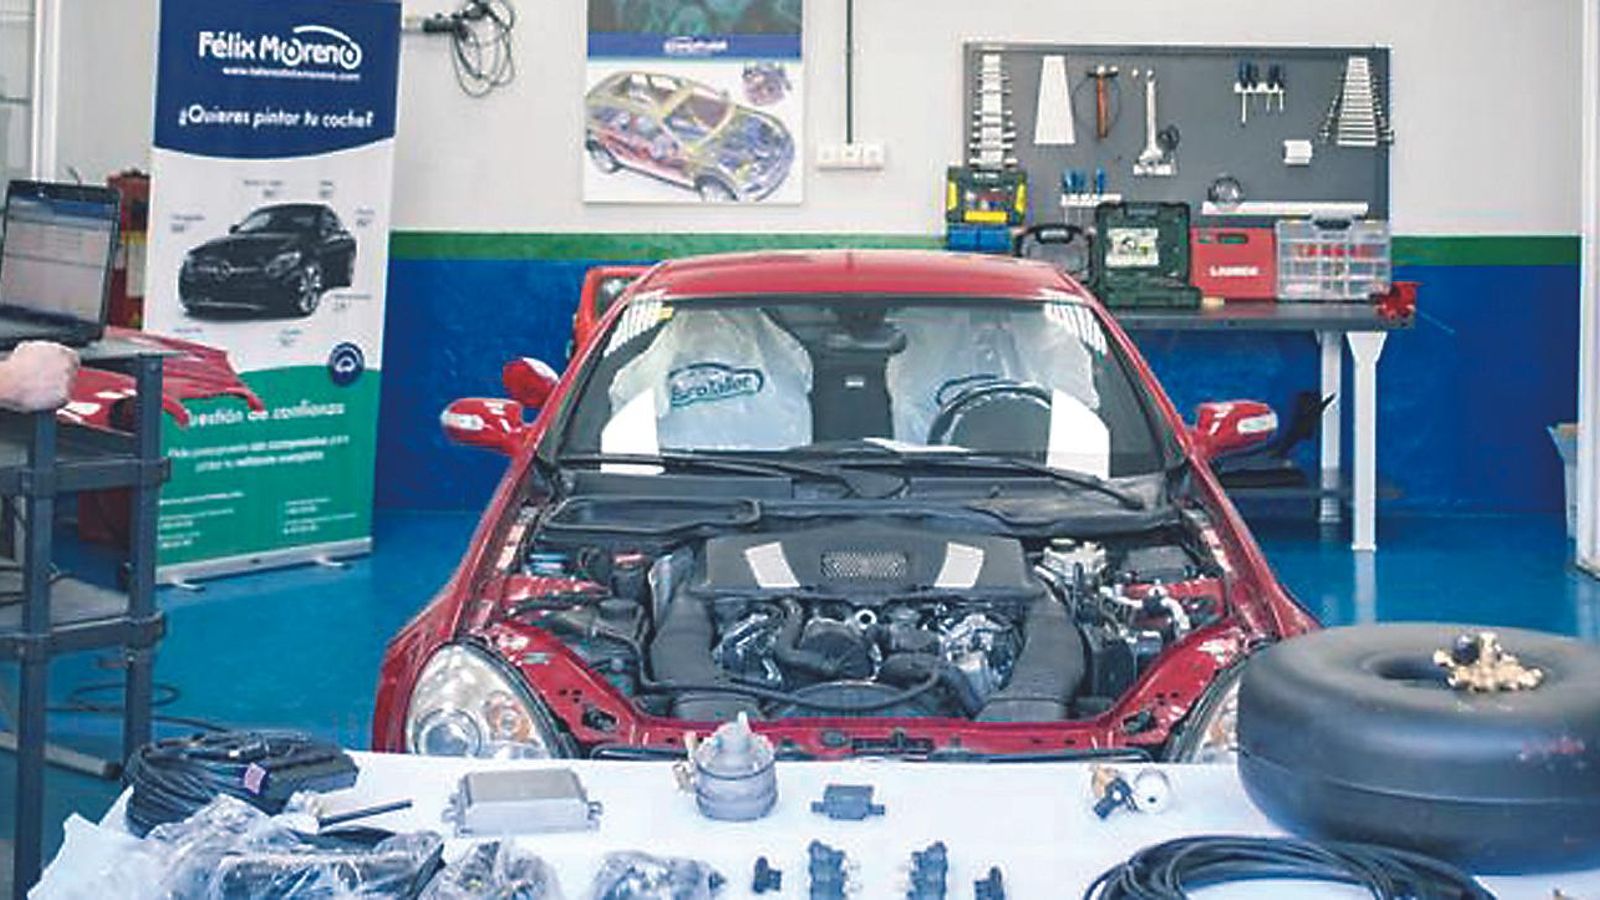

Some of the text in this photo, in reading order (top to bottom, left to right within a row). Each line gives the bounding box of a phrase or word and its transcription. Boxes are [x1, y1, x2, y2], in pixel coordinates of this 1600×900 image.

[199, 31, 362, 69] Félix Moreno
[178, 104, 374, 129] ¿Quieres pintar tu coche?
[187, 408, 243, 427] uestión
